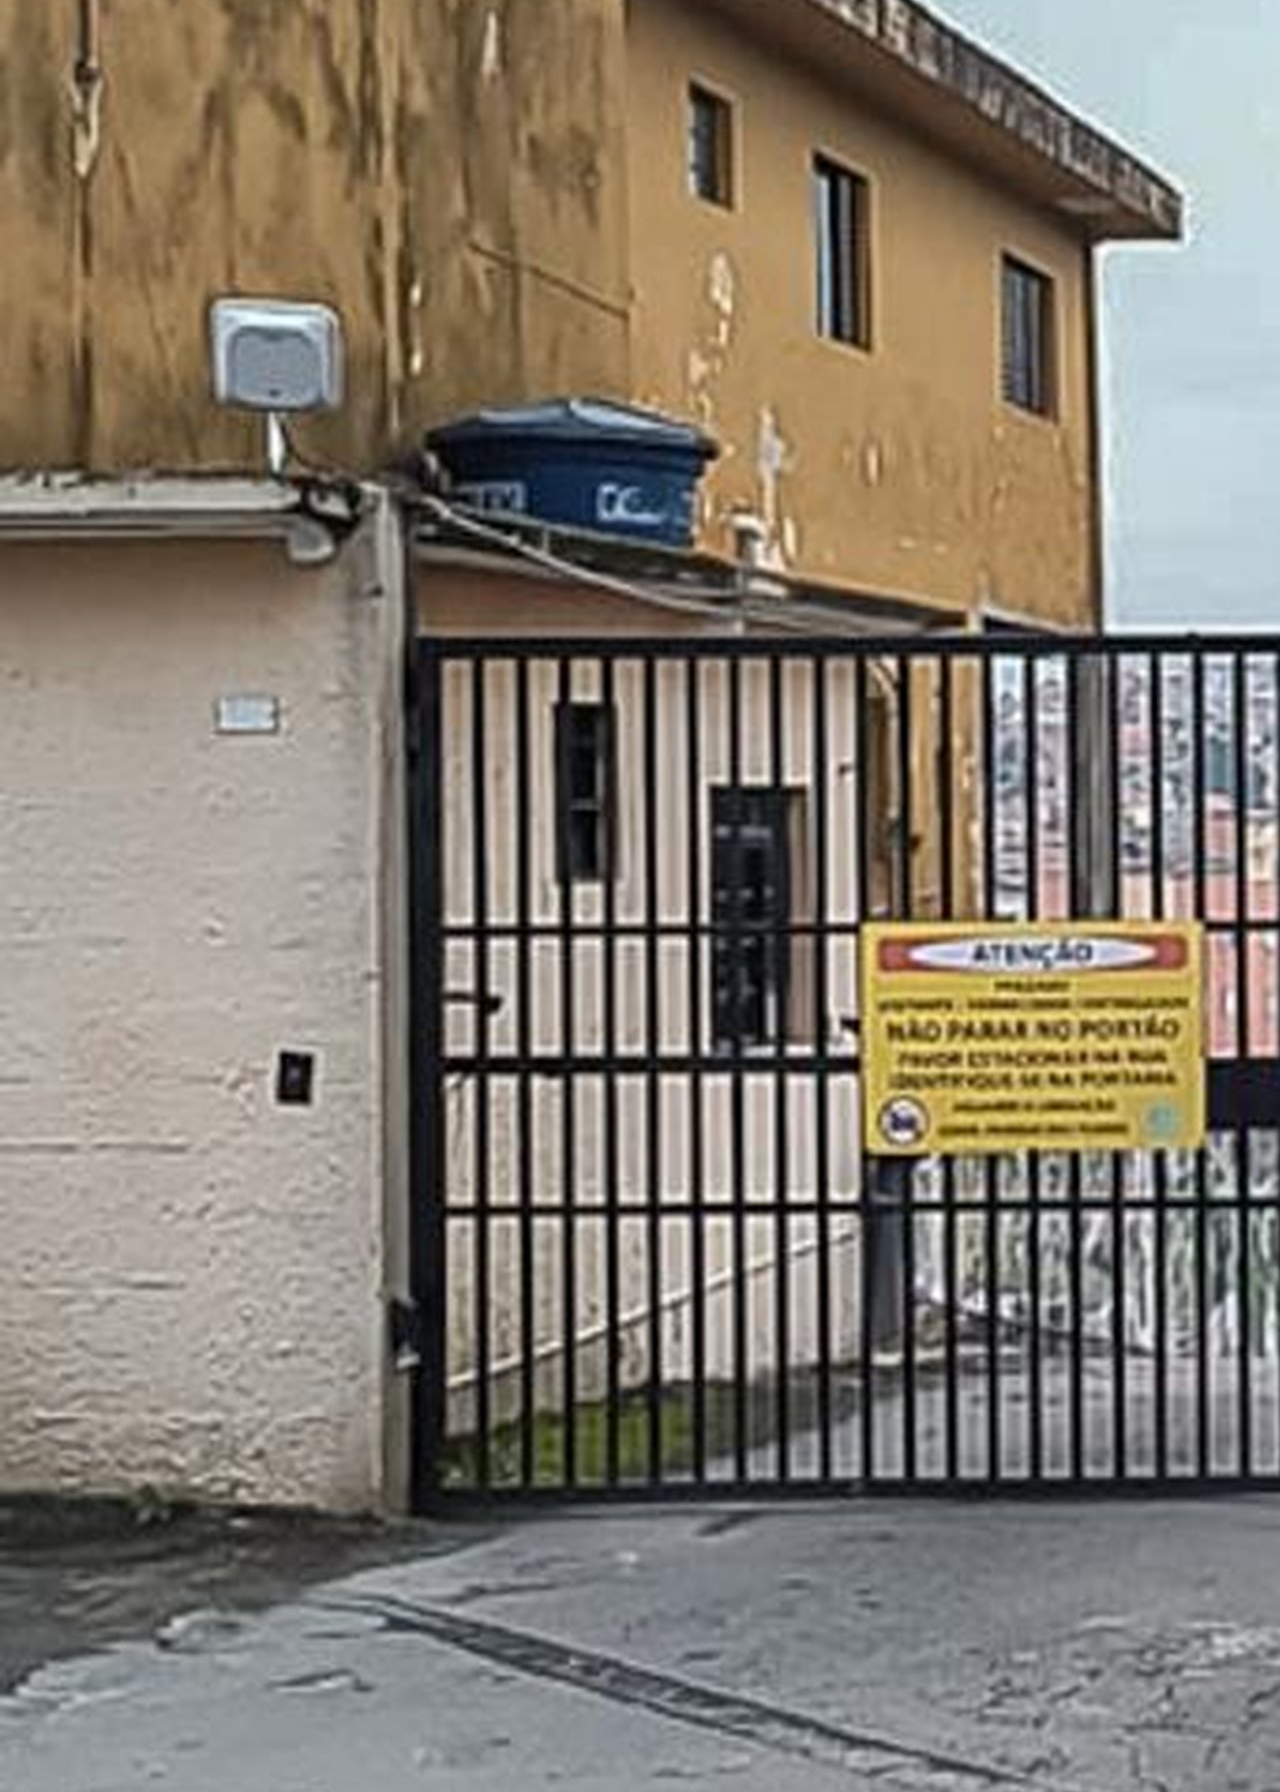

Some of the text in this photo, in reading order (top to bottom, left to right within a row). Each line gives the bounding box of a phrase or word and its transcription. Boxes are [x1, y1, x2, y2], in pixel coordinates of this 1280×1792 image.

[972, 942, 1094, 969] ATENÇÃO
[887, 1014, 1180, 1042] NÃO PARAR NO PORTÃO
